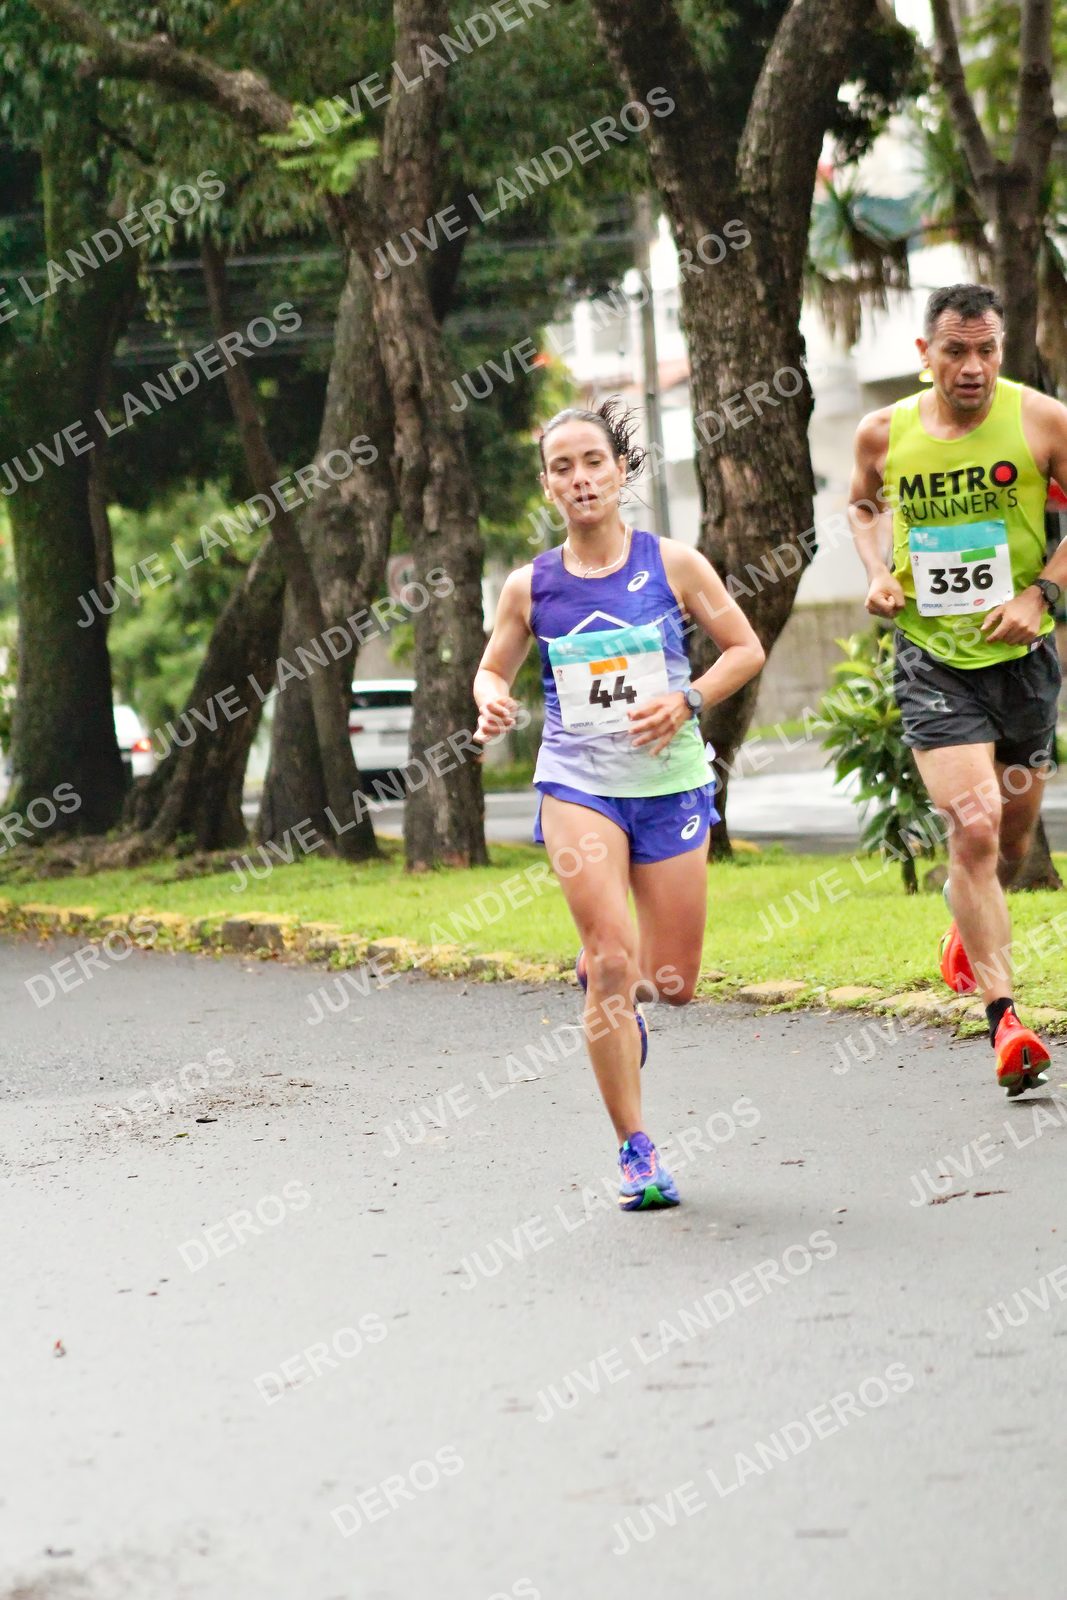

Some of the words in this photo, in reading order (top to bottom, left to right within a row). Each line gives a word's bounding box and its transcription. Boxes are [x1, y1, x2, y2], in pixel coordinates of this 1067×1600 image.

[900, 461, 1018, 500] METRO
[929, 564, 993, 595] 336
[589, 676, 637, 708] 44
